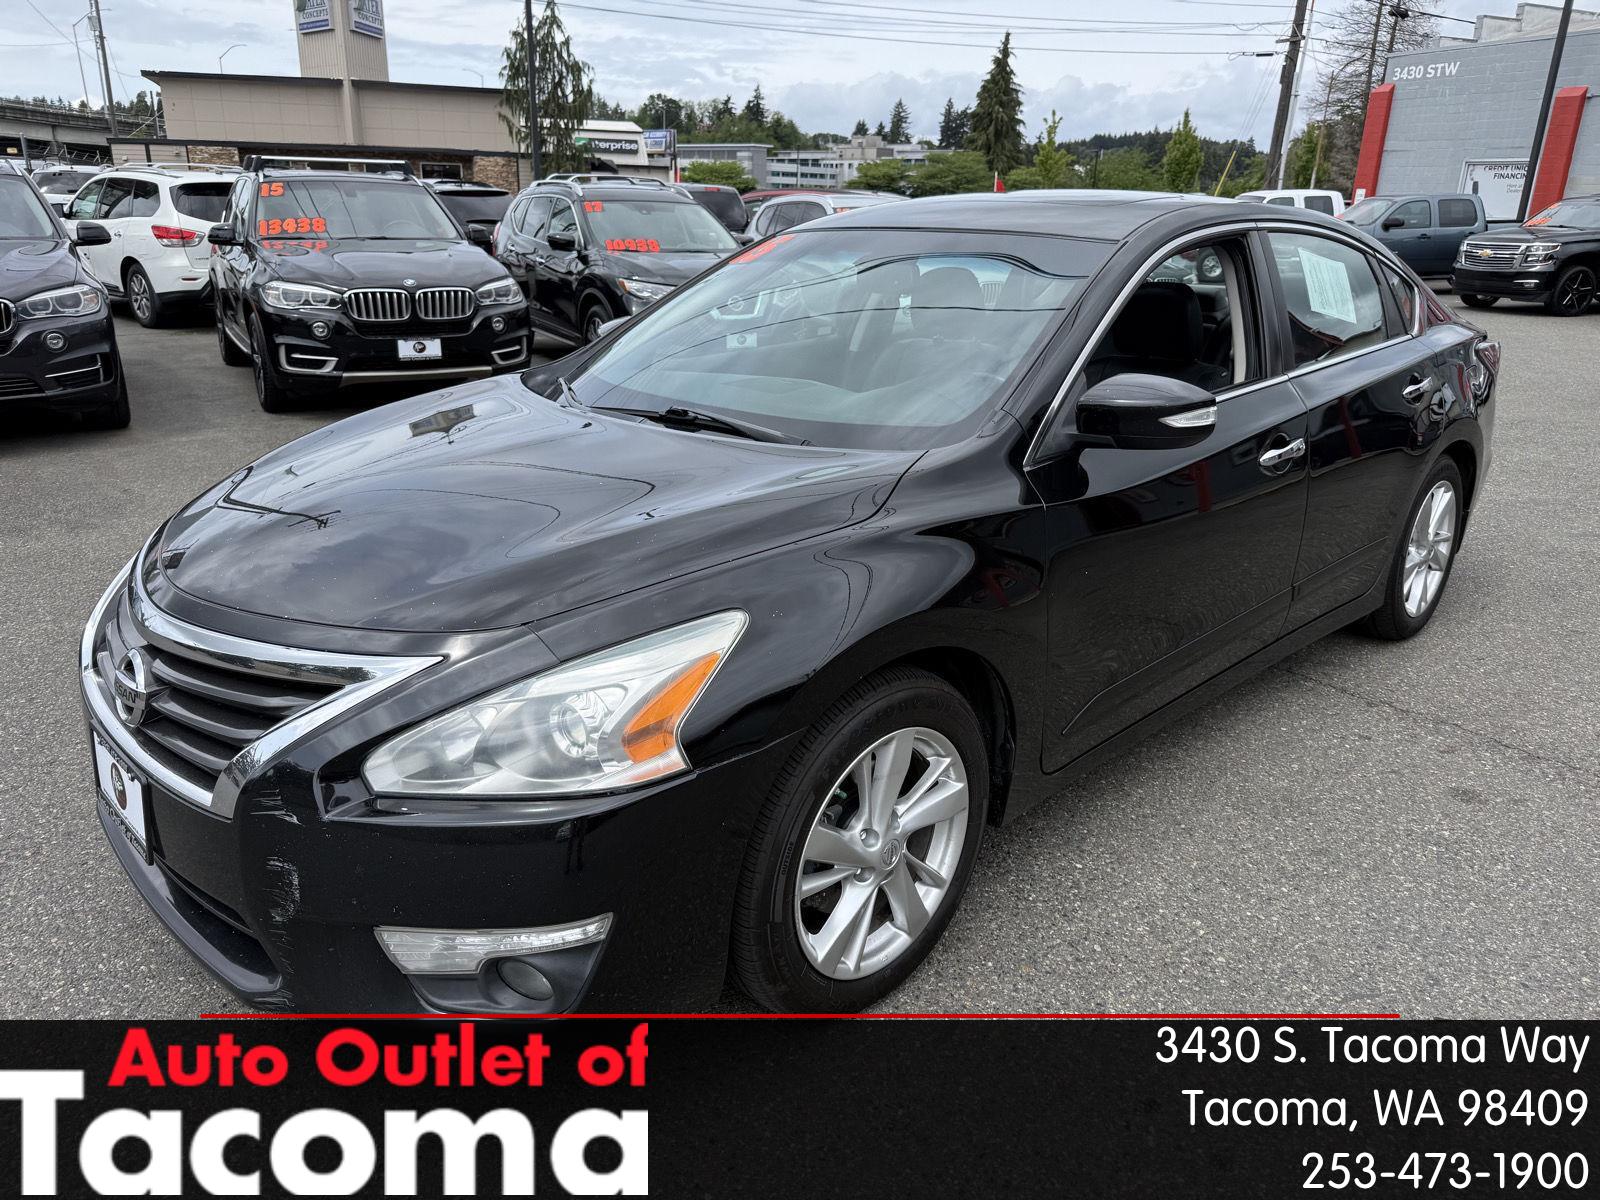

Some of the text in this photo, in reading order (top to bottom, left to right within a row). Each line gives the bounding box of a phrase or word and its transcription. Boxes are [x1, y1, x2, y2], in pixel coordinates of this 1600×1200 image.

[302, 8, 329, 20] CONCEPTS
[1392, 61, 1461, 81] 3430 STW
[1510, 164, 1529, 172] UNIO
[260, 182, 285, 197] 15
[258, 217, 327, 236] 13438
